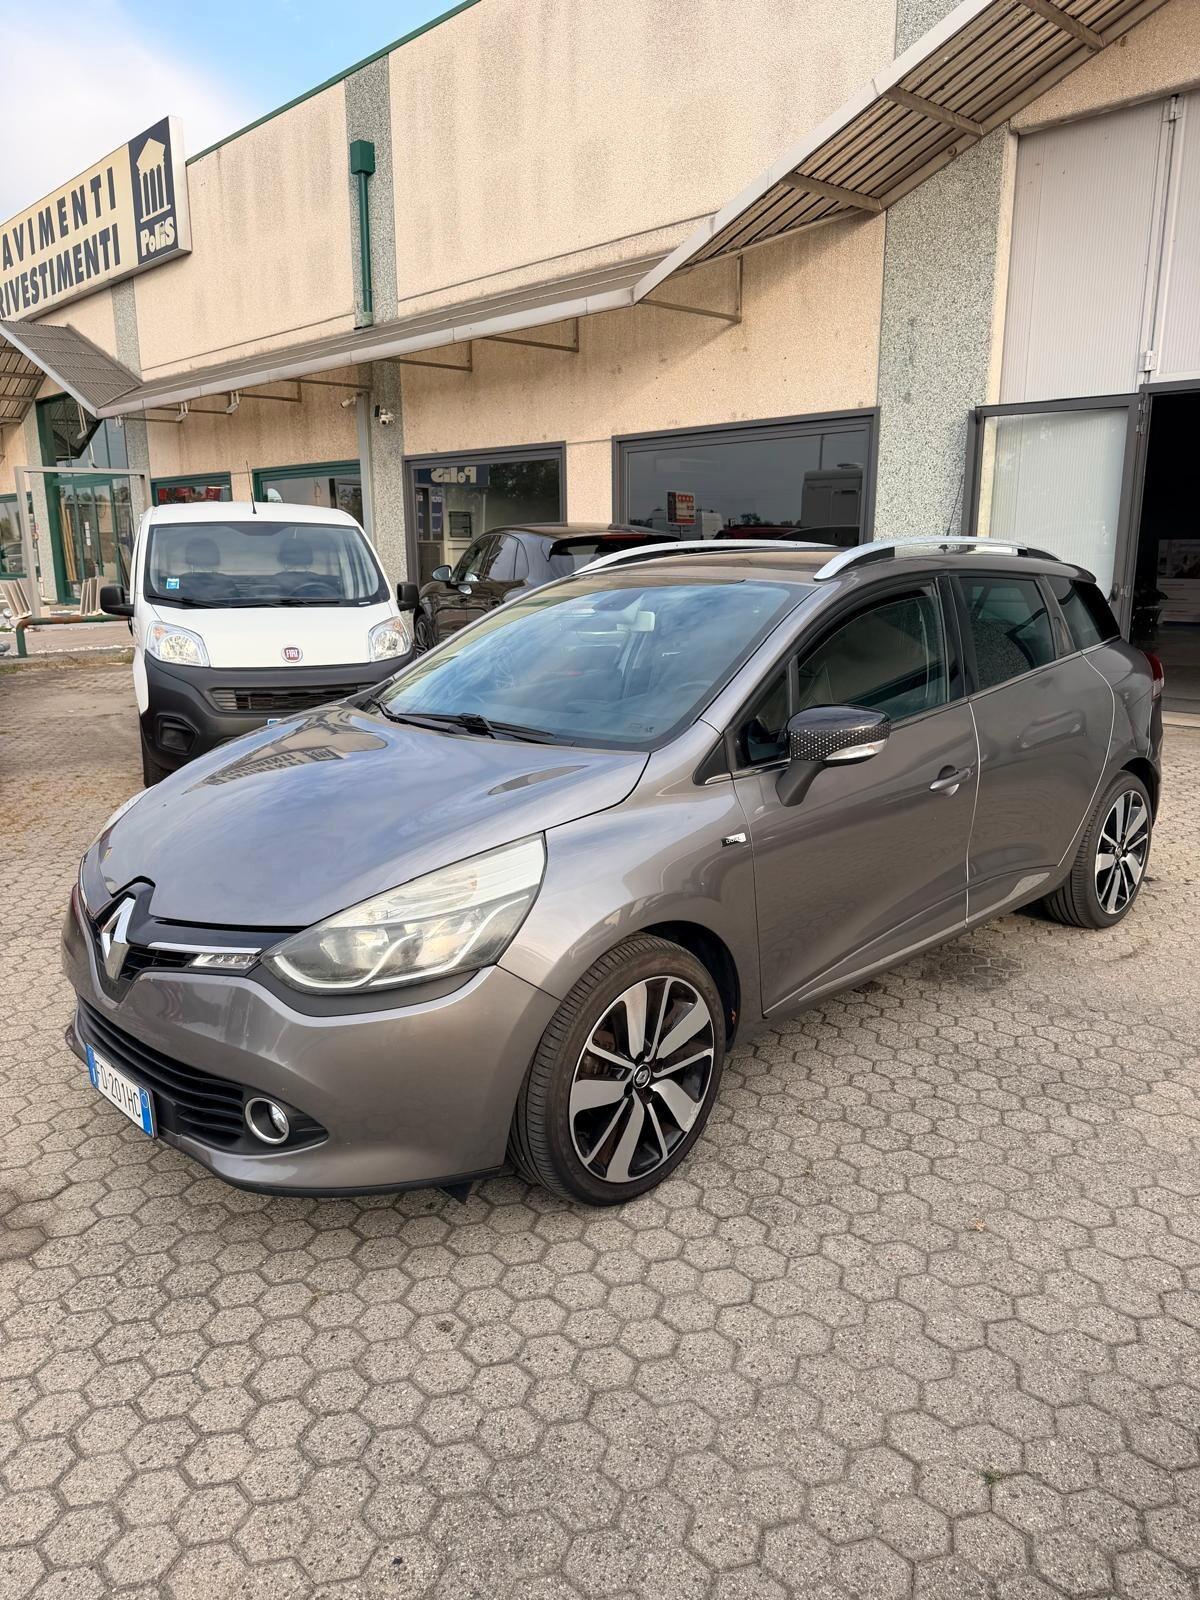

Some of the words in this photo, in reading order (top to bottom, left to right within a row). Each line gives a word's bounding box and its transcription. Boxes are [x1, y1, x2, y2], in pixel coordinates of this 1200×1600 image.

[2, 166, 116, 271] AVIMENTI
[0, 223, 121, 319] RIVESTIMENTI
[285, 649, 299, 658] FIAT
